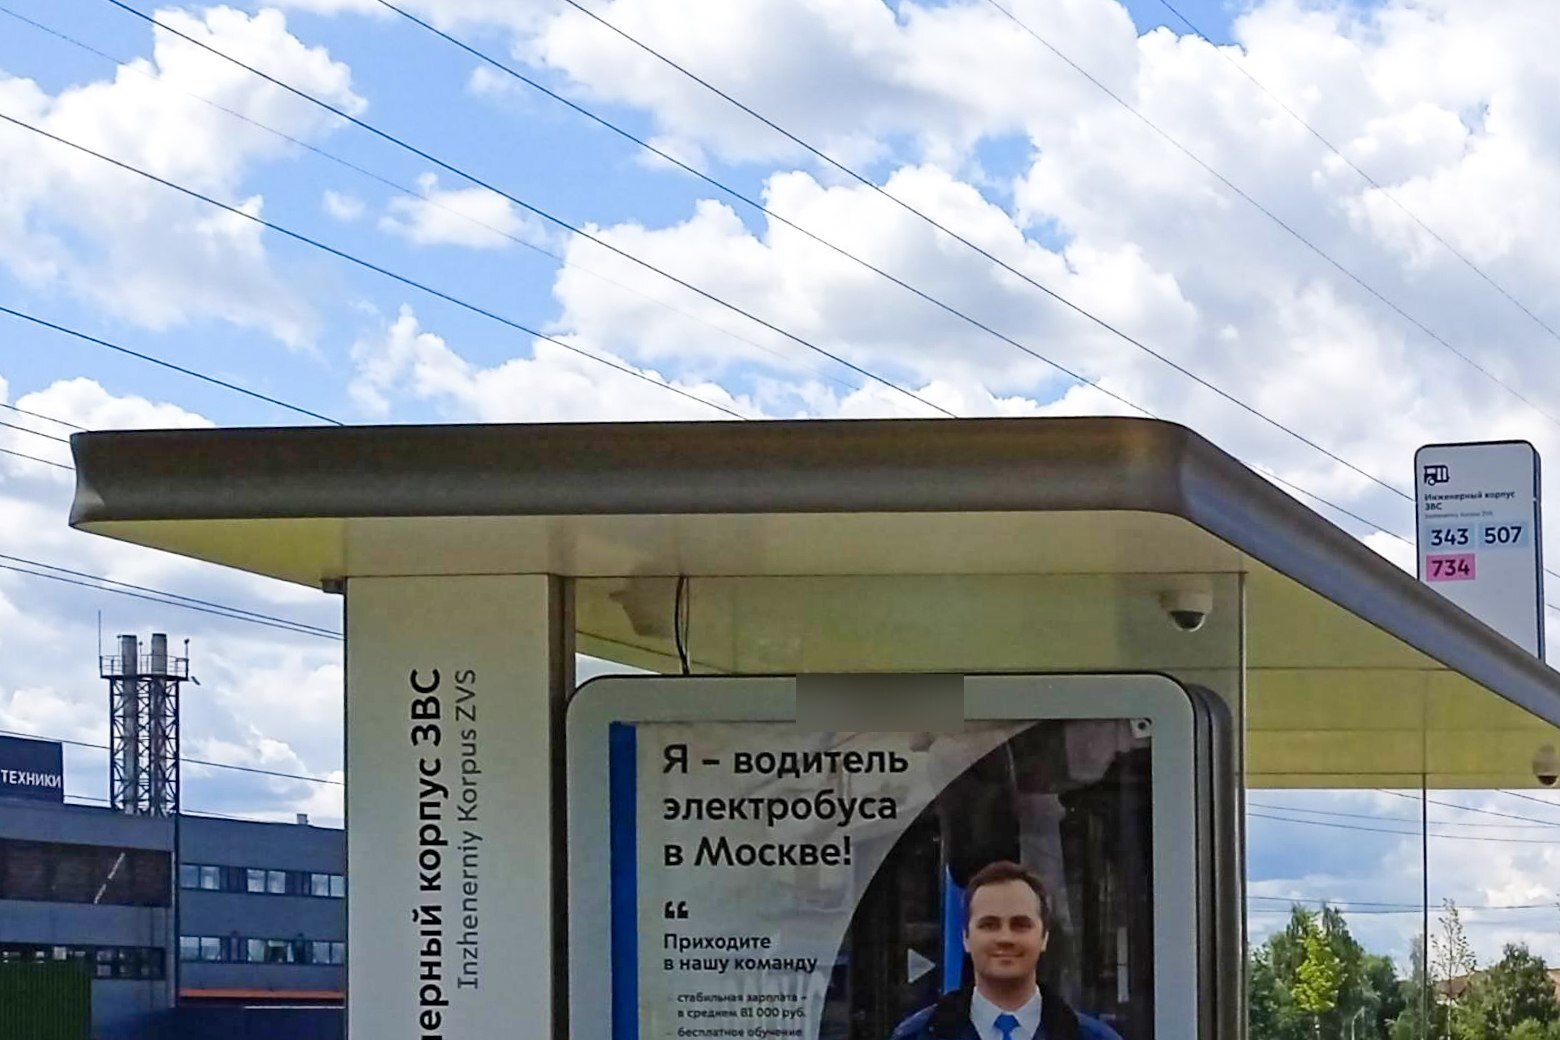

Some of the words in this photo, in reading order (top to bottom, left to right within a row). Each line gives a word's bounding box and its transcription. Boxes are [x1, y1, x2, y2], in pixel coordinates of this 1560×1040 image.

[1431, 528, 1468, 546] 343
[1484, 526, 1522, 544] 507
[1432, 559, 1470, 577] 734
[411, 669, 440, 745] ЗВС
[455, 669, 476, 721] ZVS
[663, 744, 688, 774] Я
[734, 750, 909, 778] водитель
[1, 769, 61, 788] ТЕХНИКИ
[457, 729, 482, 821] Korpus
[663, 789, 897, 826] электробуса
[417, 758, 448, 891] корпус
[664, 843, 683, 866] в
[694, 836, 852, 866] Москве!
[457, 827, 482, 989] Inzhenerniy
[664, 933, 770, 953] Приходите
[664, 956, 674, 970] в
[679, 956, 728, 974] нашу
[734, 956, 817, 974] команду
[678, 992, 744, 1003] стабильная
[747, 994, 798, 1005] зарплата
[678, 1010, 684, 1018] в
[687, 1009, 738, 1019] среднем
[757, 1008, 779, 1018] 000
[782, 1007, 806, 1020] руб.
[678, 1027, 744, 1037] бесплатное
[747, 1027, 802, 1039] обучение
